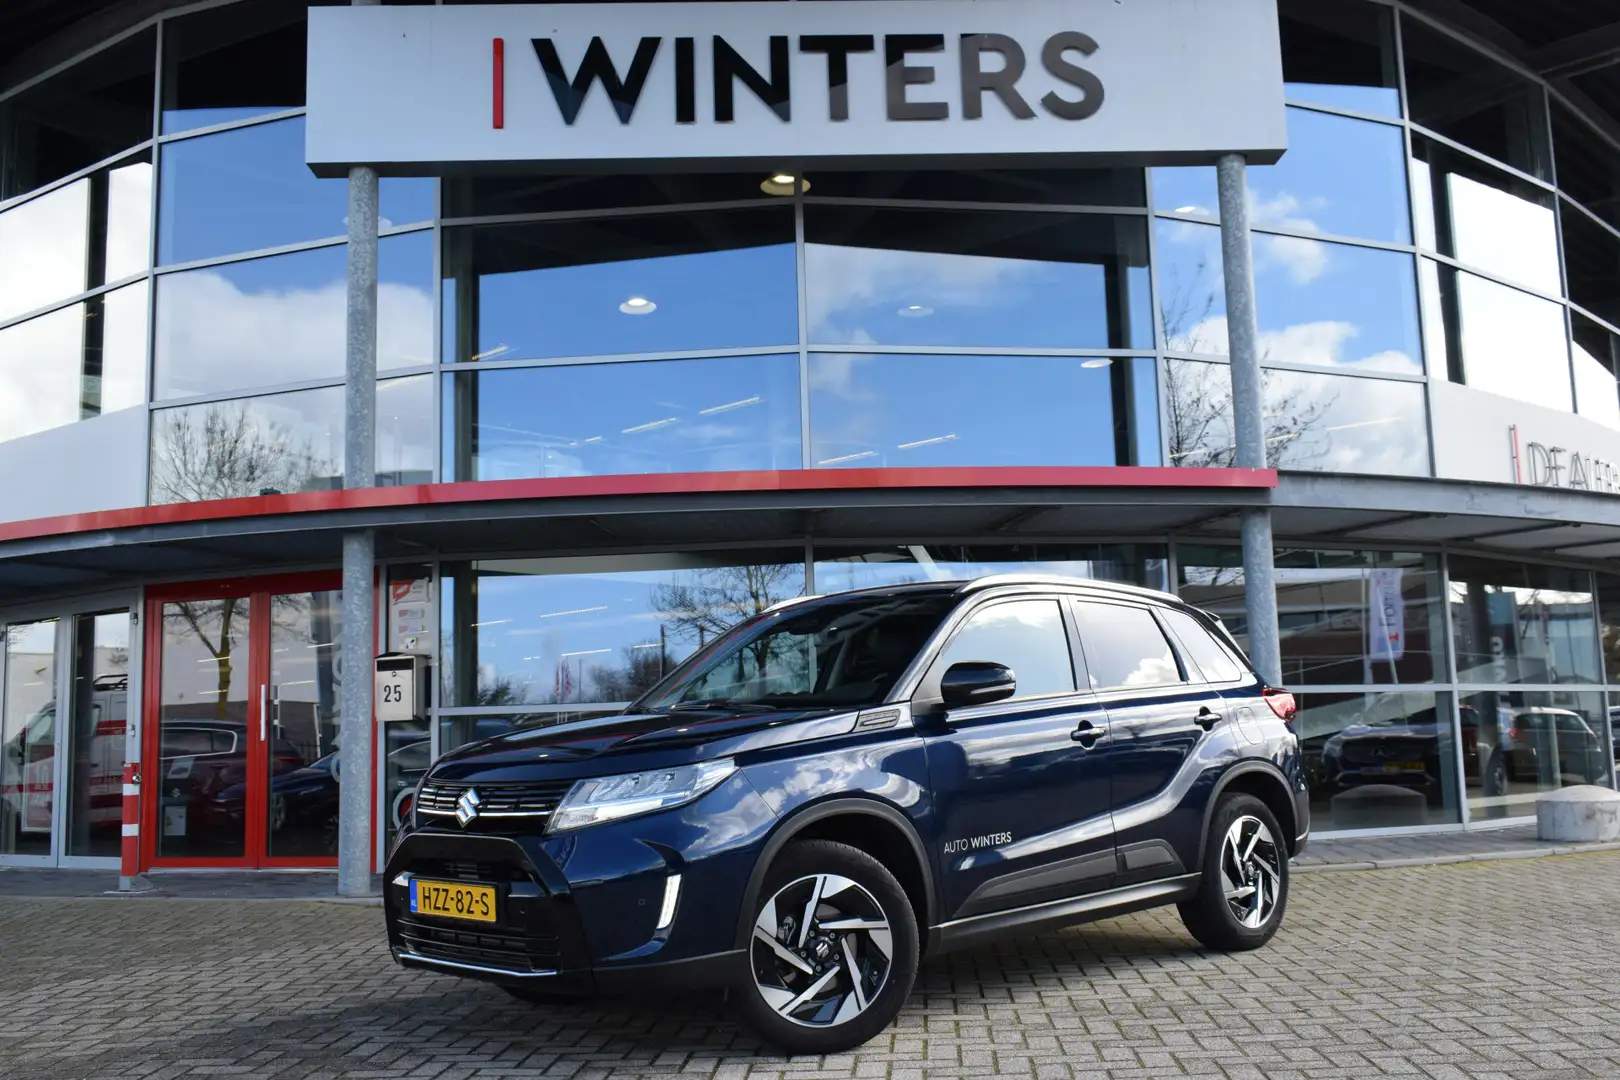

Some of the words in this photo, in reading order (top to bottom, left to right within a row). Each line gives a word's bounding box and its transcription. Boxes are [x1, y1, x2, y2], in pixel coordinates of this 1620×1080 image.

[530, 30, 1105, 126] WINTERS
[383, 684, 402, 703] 25
[943, 838, 968, 855] AUTO
[970, 831, 1012, 849] WINTERS
[422, 886, 489, 916] HZZ-82-S
